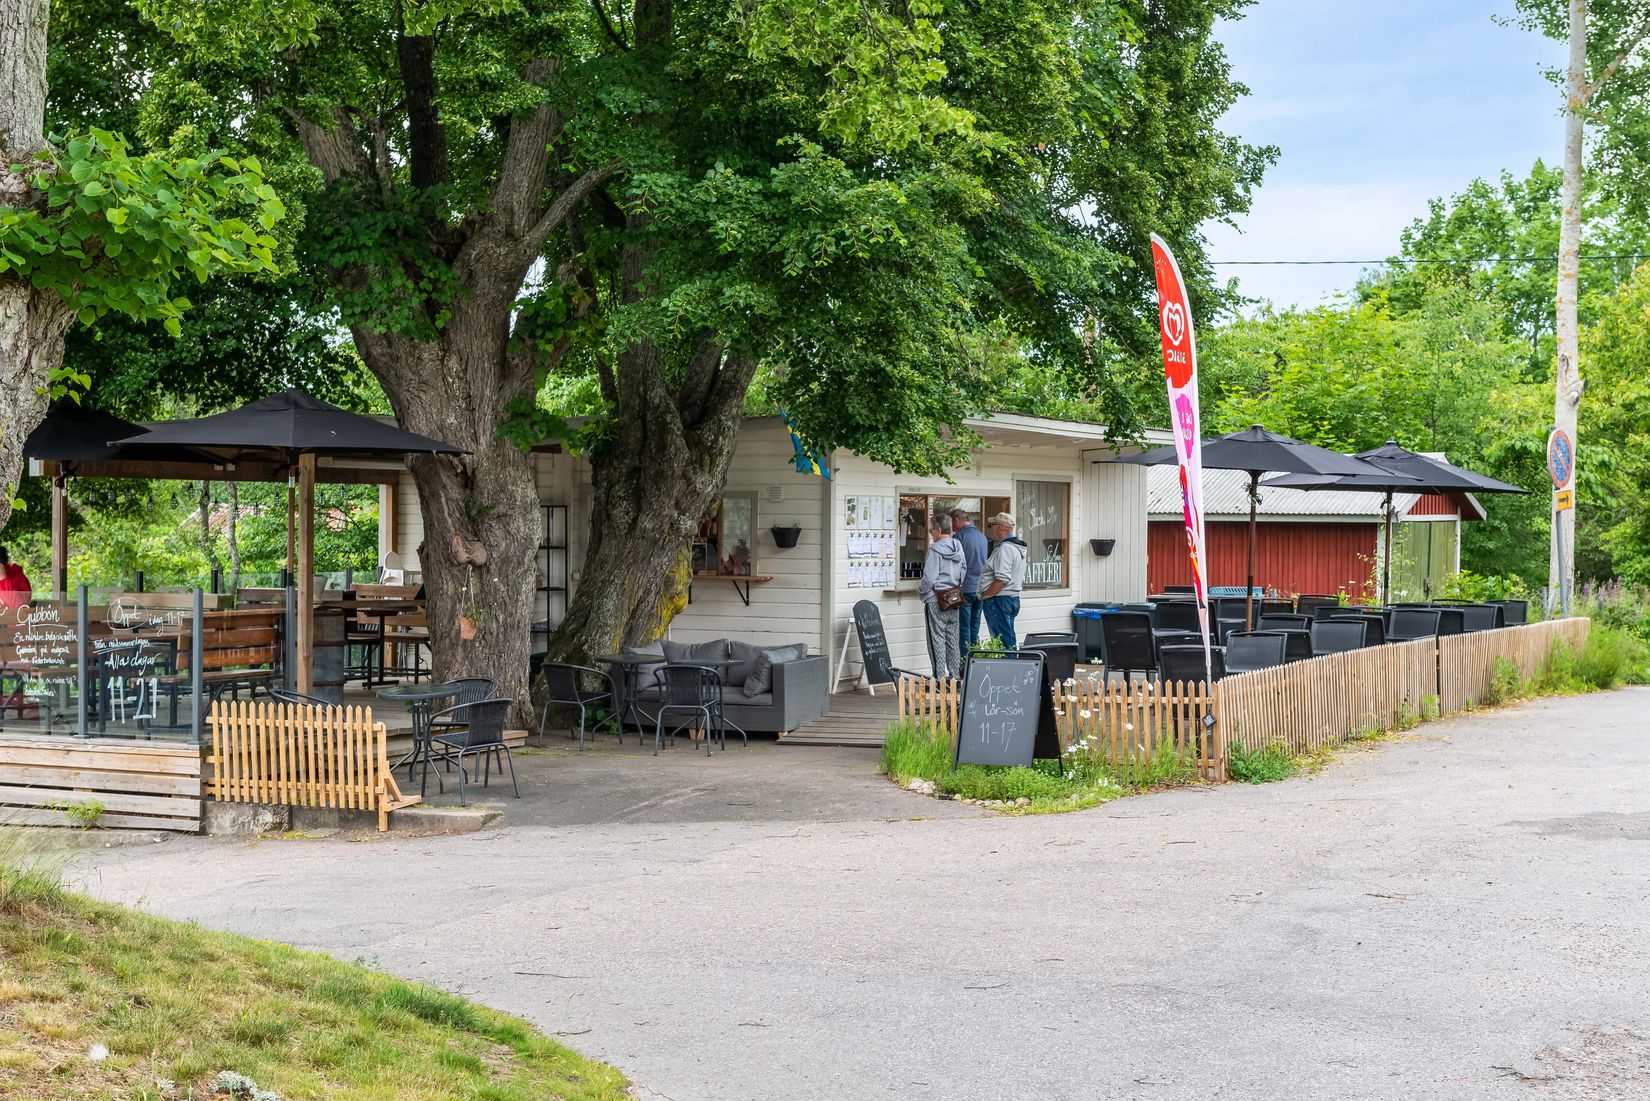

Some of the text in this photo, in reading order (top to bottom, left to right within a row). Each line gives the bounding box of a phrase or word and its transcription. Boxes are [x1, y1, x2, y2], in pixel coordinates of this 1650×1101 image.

[1023, 557, 1062, 583] ÅFFLERI
[114, 599, 142, 627] Öppet
[166, 610, 186, 626] 11-17
[105, 651, 162, 676] Alla dagar
[979, 665, 1021, 703] Öppet
[107, 676, 157, 724] 11-21
[980, 721, 1016, 752] 11-17
